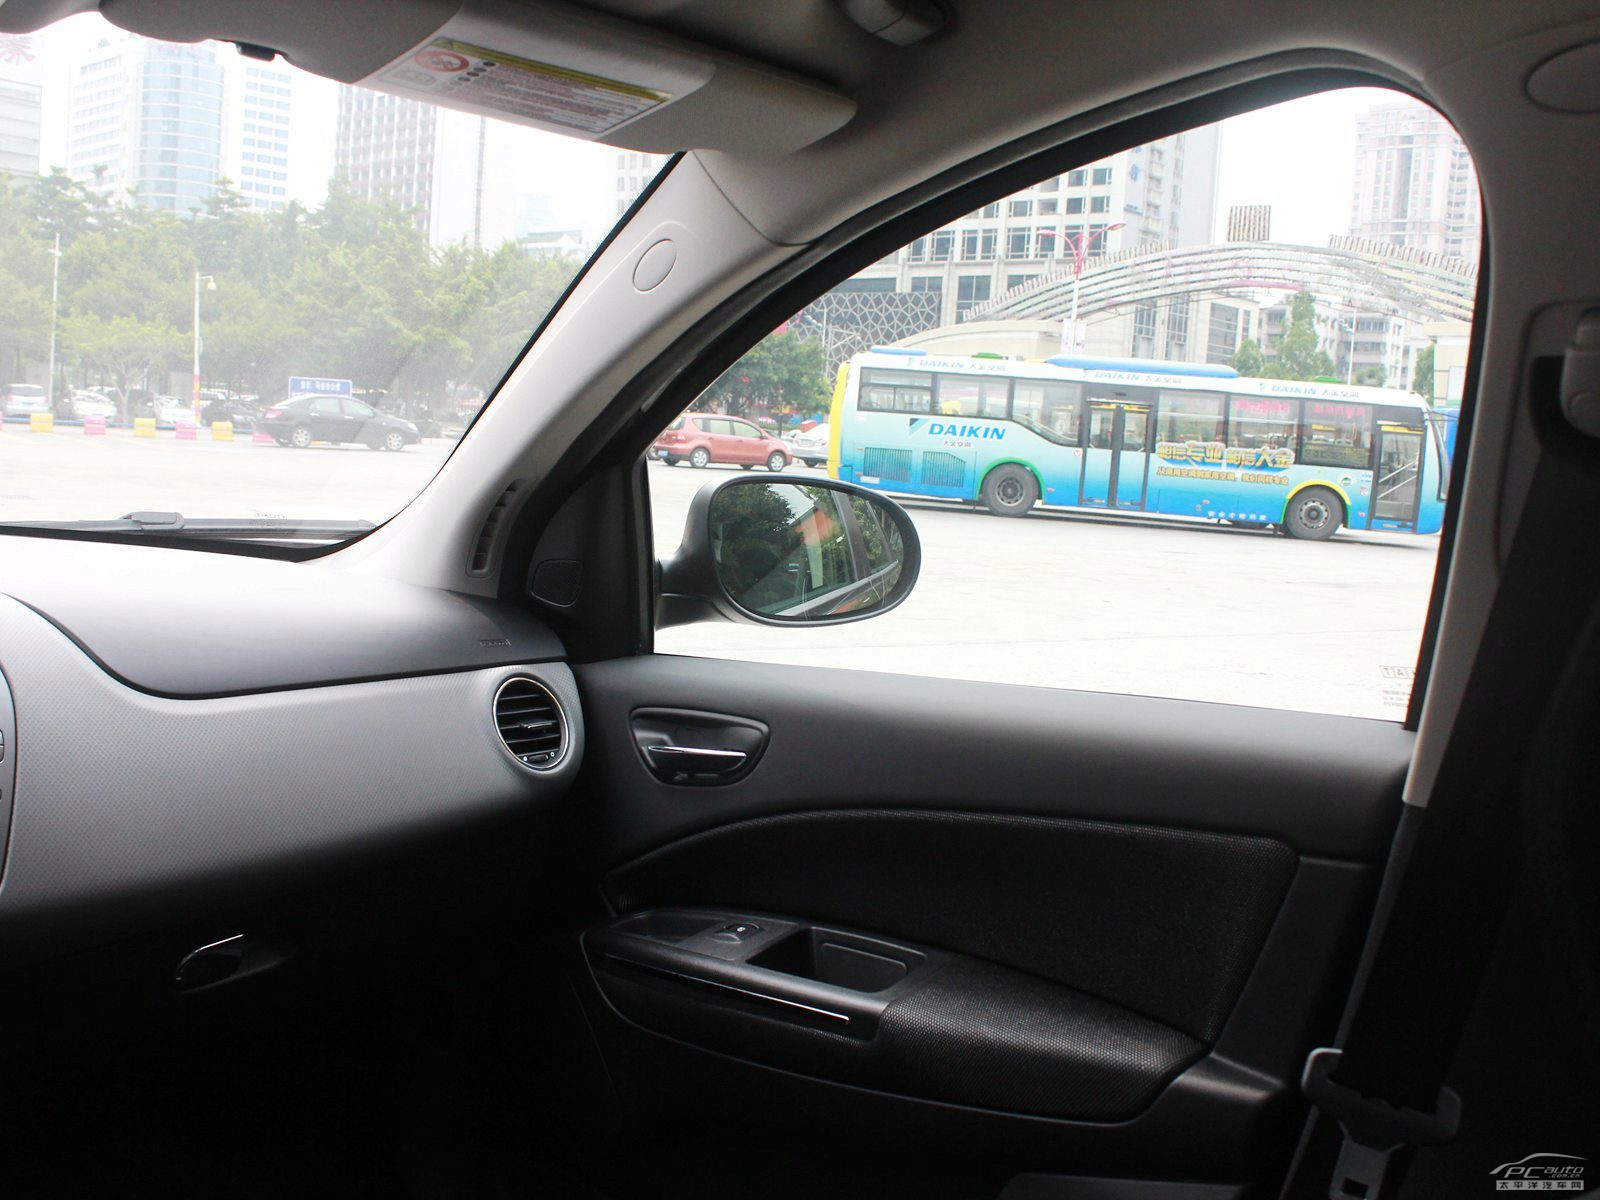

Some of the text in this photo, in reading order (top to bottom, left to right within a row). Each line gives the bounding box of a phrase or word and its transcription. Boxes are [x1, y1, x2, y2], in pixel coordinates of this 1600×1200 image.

[919, 359, 964, 369] DAIKIN
[1094, 371, 1140, 381] DAIKIN
[1272, 385, 1317, 395] DAIKIN
[928, 423, 1006, 440] DAIKIN
